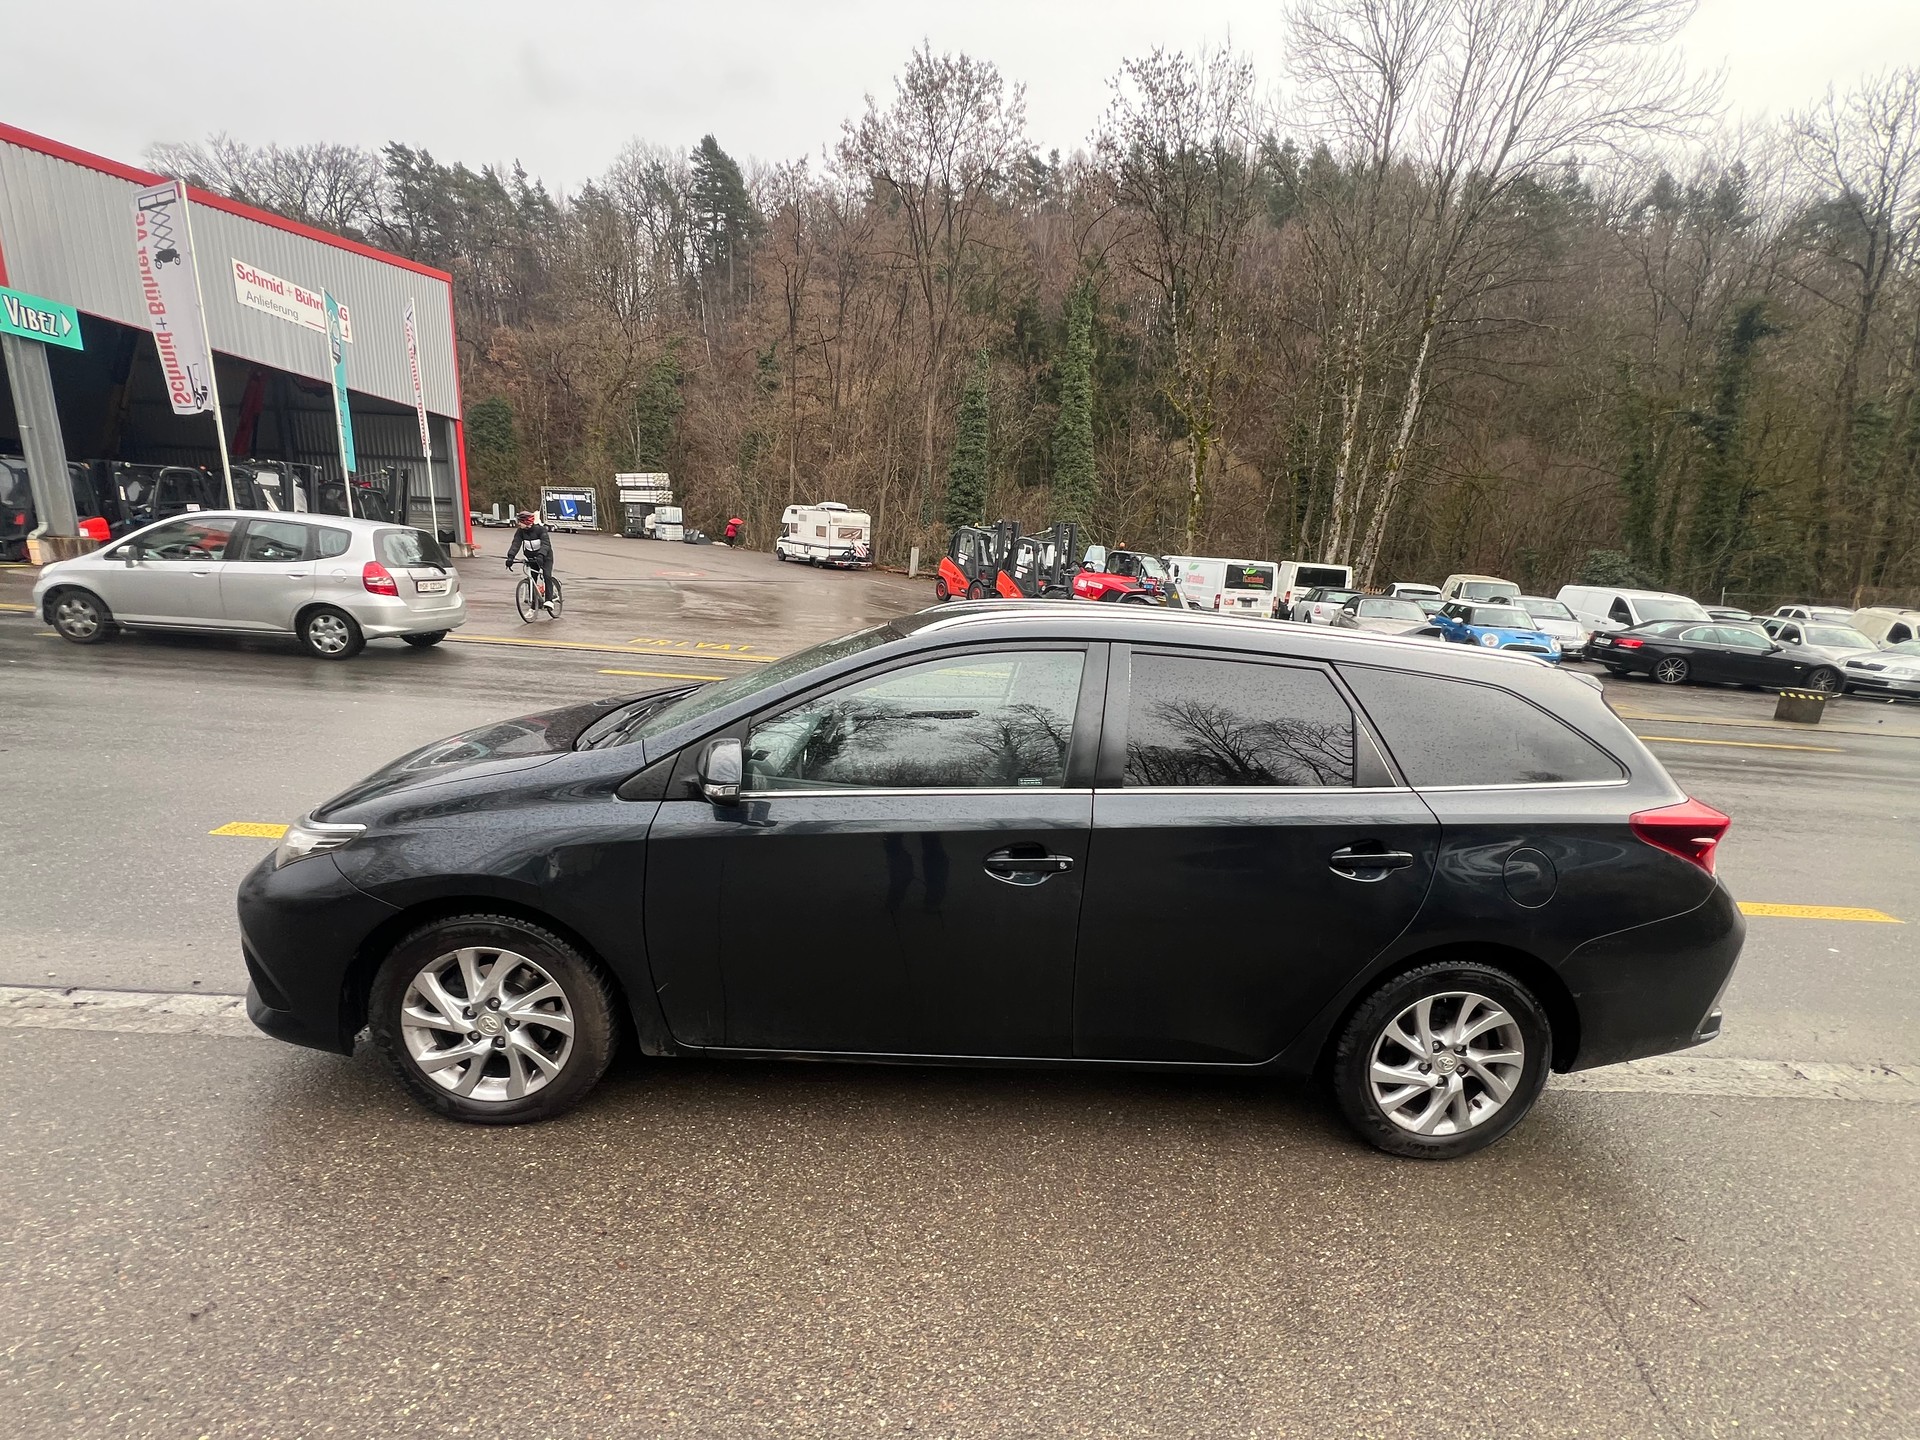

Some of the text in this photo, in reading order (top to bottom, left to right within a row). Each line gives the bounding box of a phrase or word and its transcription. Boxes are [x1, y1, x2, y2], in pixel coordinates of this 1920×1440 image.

[236, 263, 284, 296] Schmid
[246, 290, 299, 321] Anlieferung
[627, 638, 755, 651] PRIVAT
